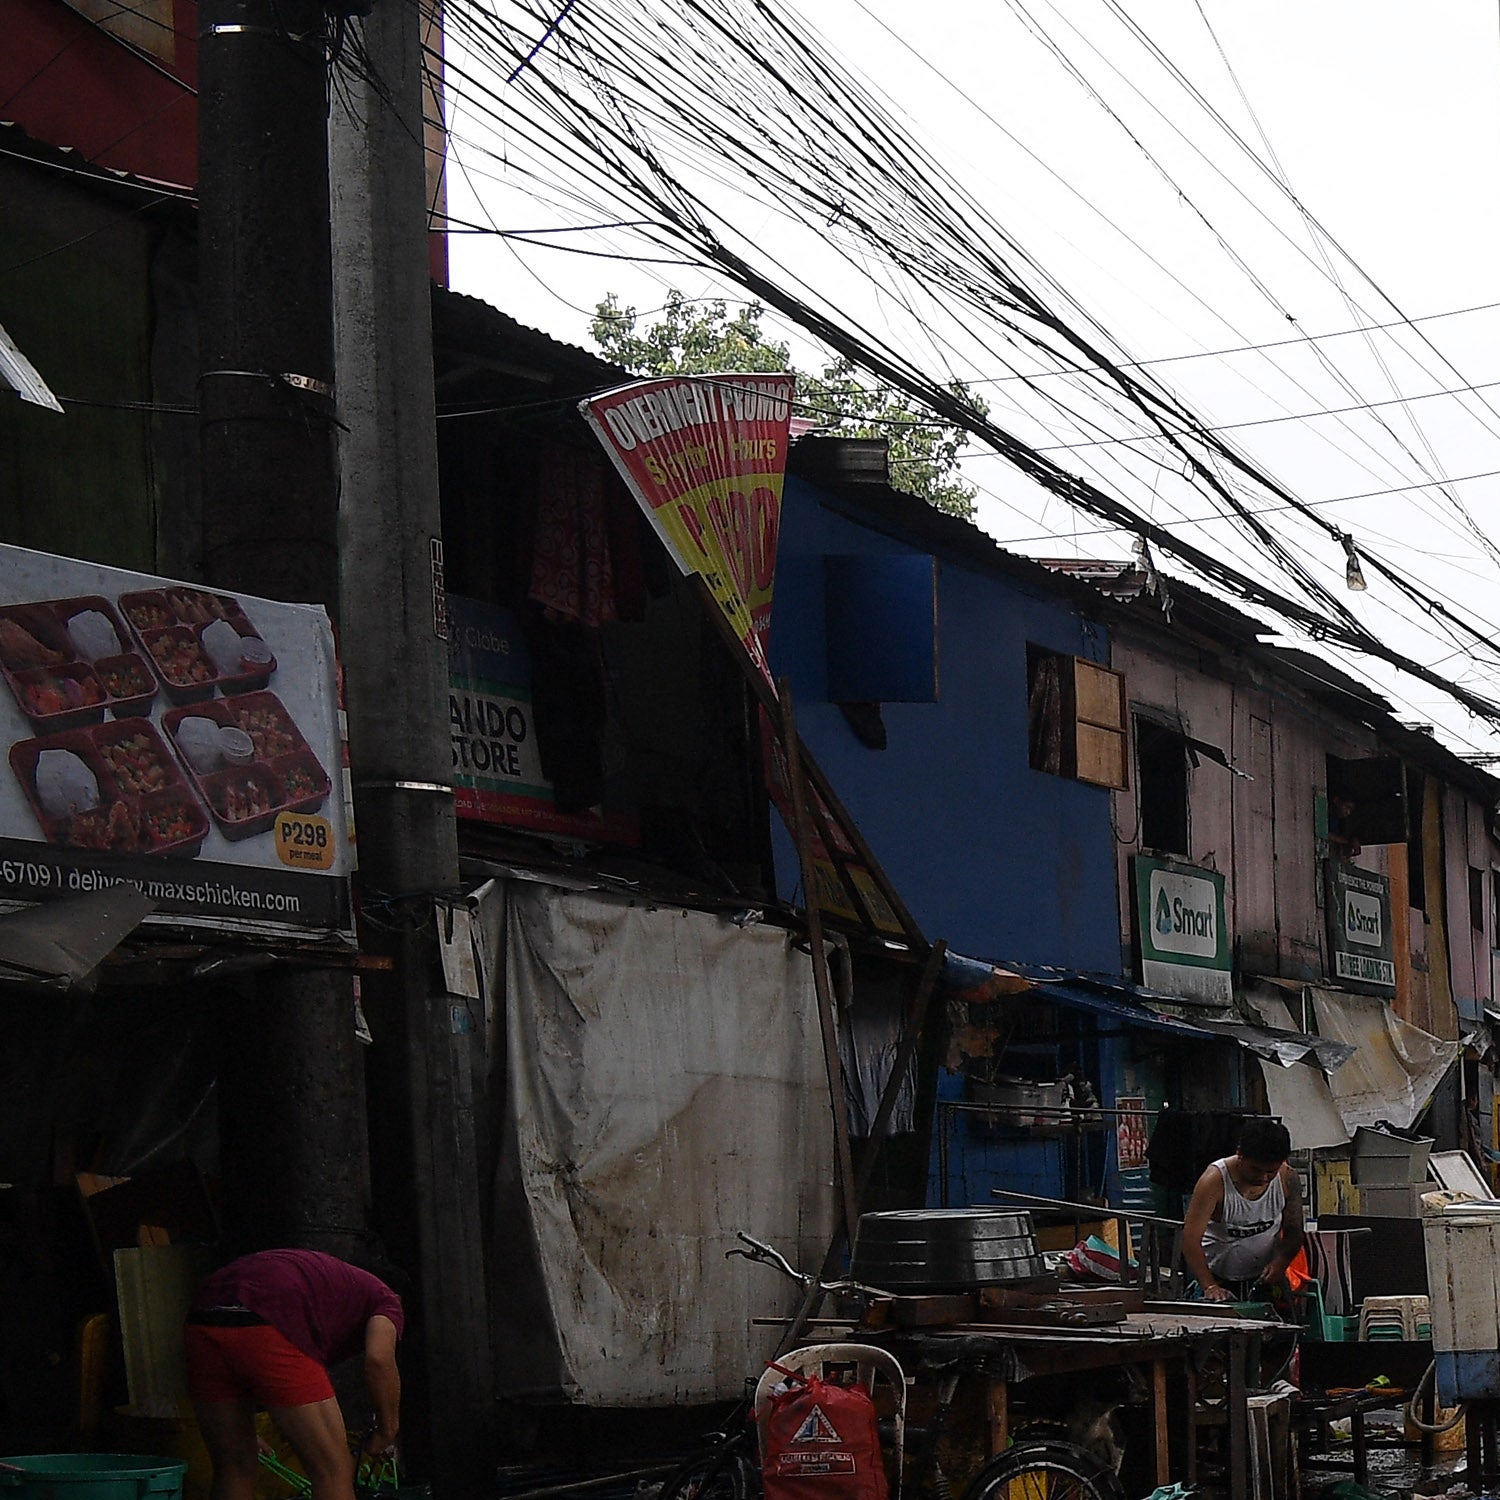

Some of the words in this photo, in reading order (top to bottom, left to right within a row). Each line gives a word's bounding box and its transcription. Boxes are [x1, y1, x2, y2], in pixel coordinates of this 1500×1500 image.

[604, 384, 718, 451] OVERNIGHT
[720, 380, 789, 424] PROMO
[731, 432, 778, 462] Hours
[465, 626, 513, 655] Globe
[69, 868, 300, 912] delivy.maxschicken.com
[1173, 897, 1214, 939] Smart
[1356, 908, 1380, 935] Smart
